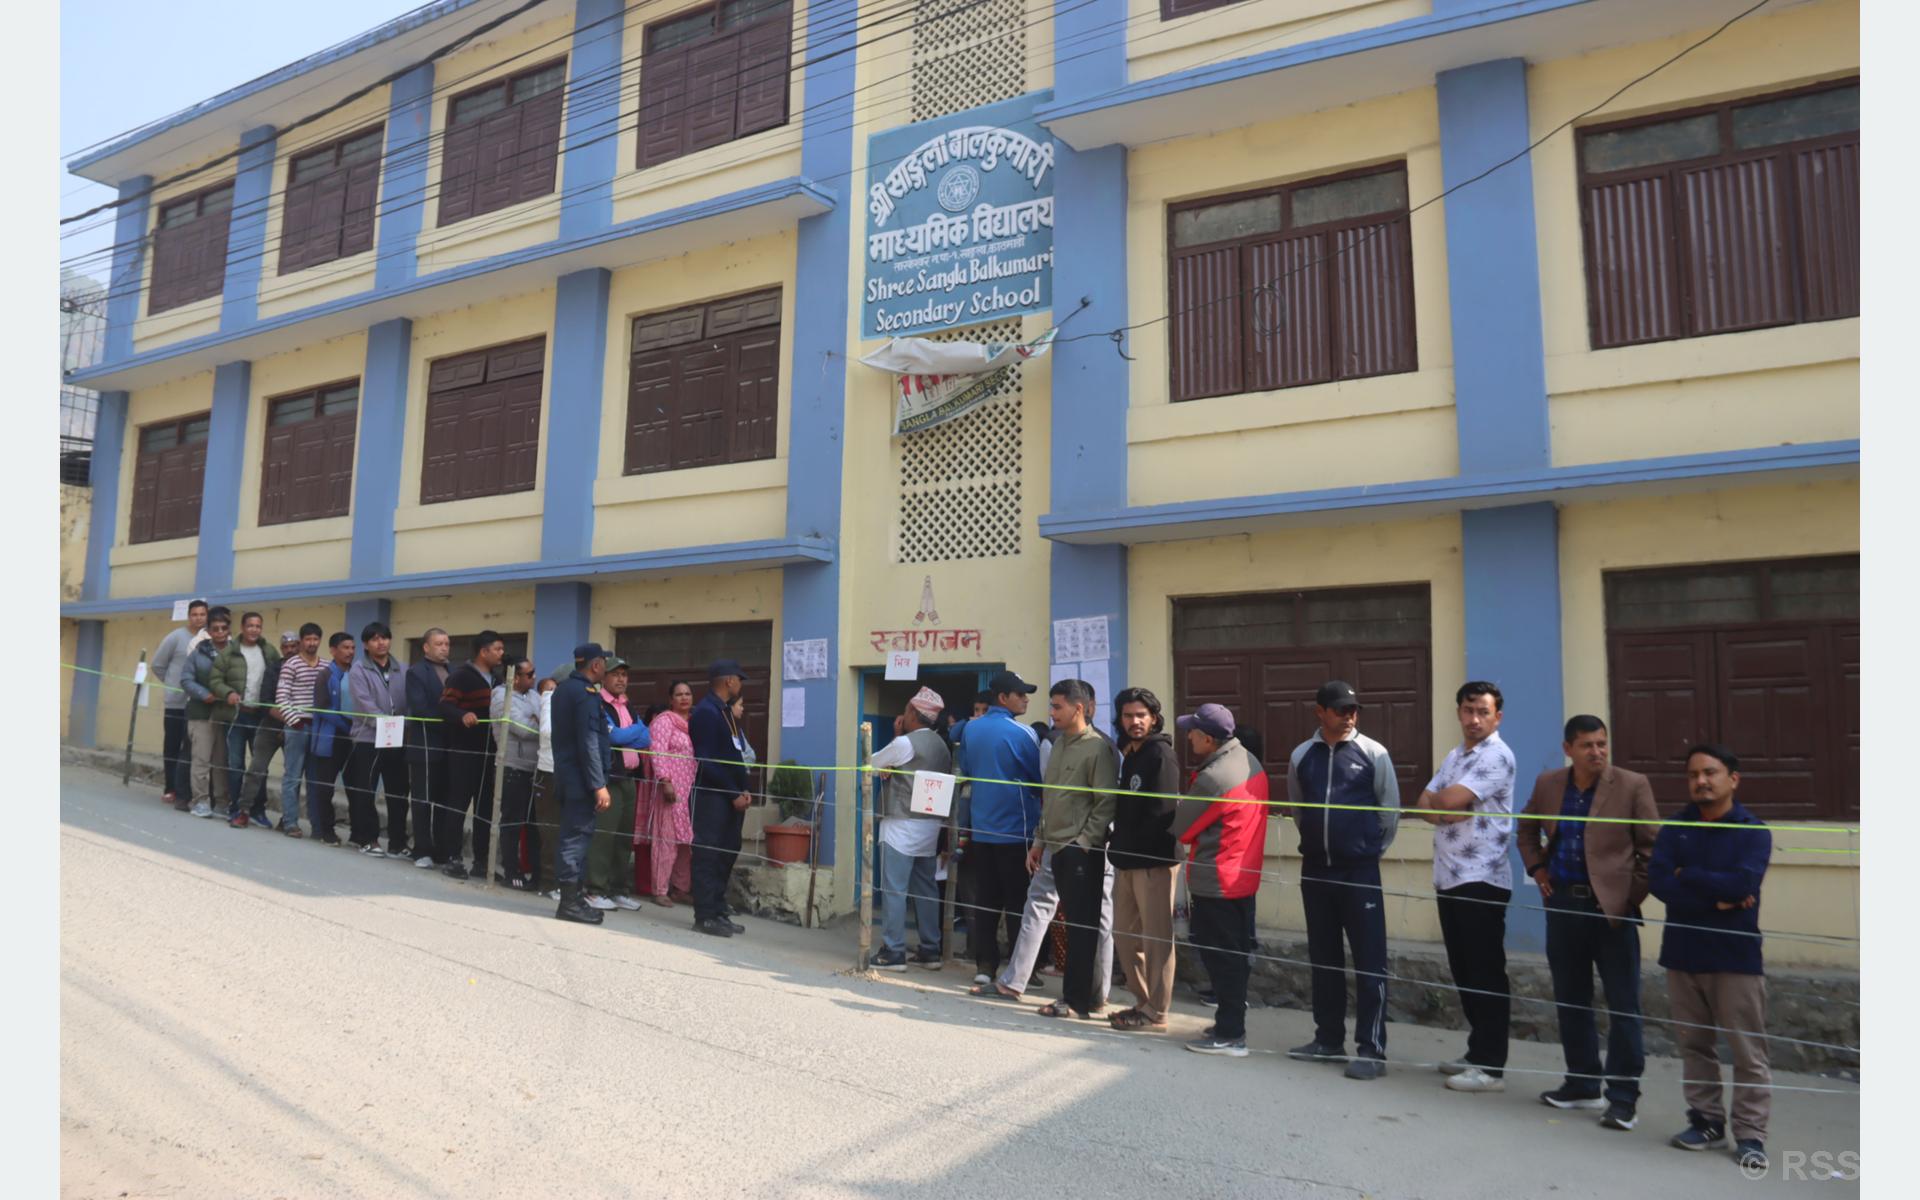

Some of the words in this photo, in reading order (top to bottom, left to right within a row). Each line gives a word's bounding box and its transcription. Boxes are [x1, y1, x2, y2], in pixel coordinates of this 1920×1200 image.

[869, 182, 895, 227] श्री
[869, 212, 969, 262] माध्यमिक
[972, 196, 1054, 243] विद्यालय
[867, 277, 914, 302] Shree
[917, 262, 967, 292] Sangla
[969, 246, 1054, 284] Balkumari
[876, 298, 965, 331] Secondary
[970, 276, 1040, 314] School
